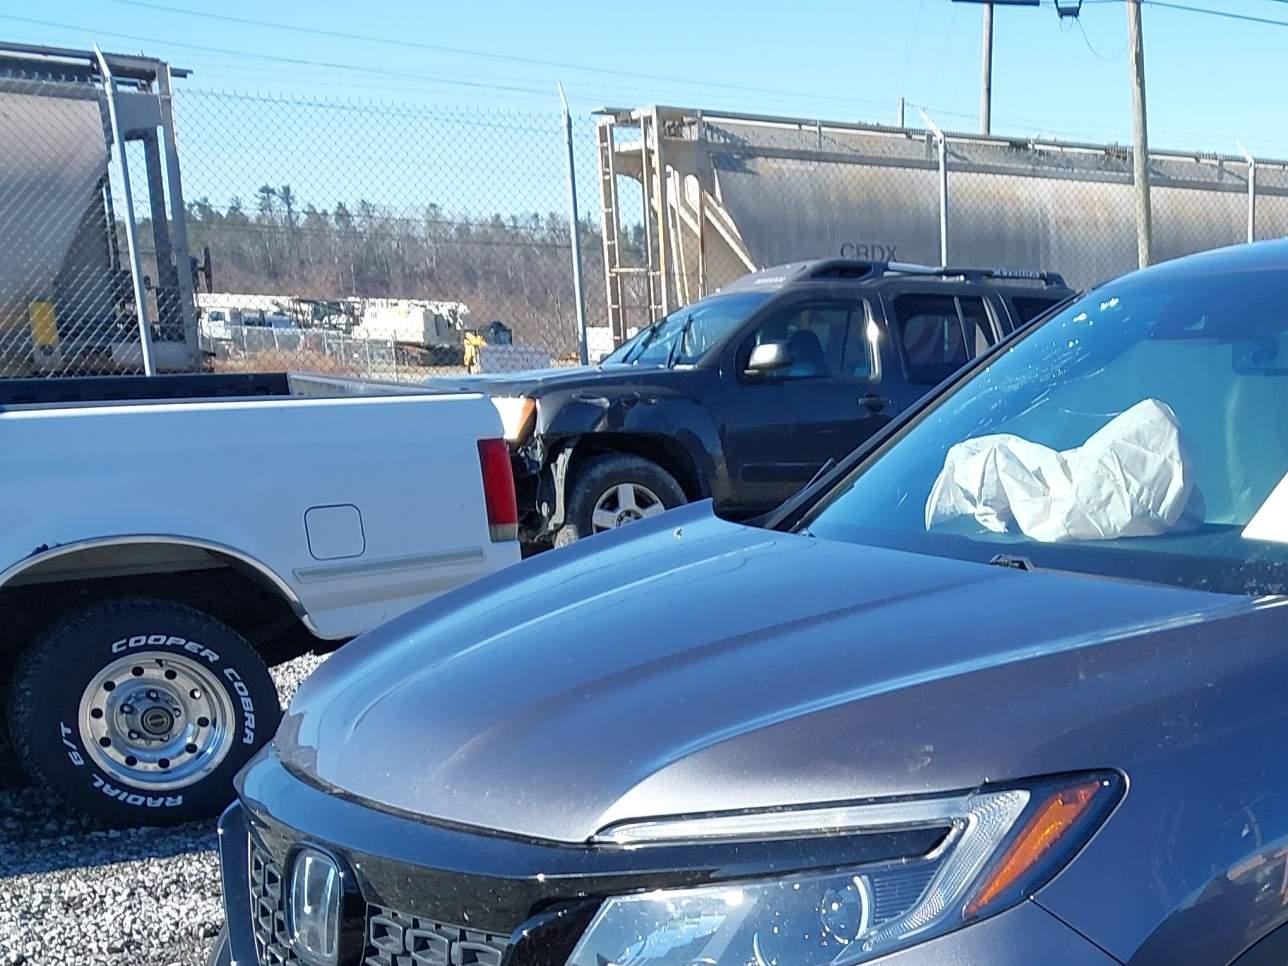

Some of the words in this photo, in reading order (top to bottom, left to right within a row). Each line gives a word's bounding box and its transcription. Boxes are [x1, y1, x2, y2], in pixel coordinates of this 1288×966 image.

[111, 634, 220, 664] COOPER
[223, 667, 257, 746] COBRA
[92, 774, 183, 808] RADIAL
